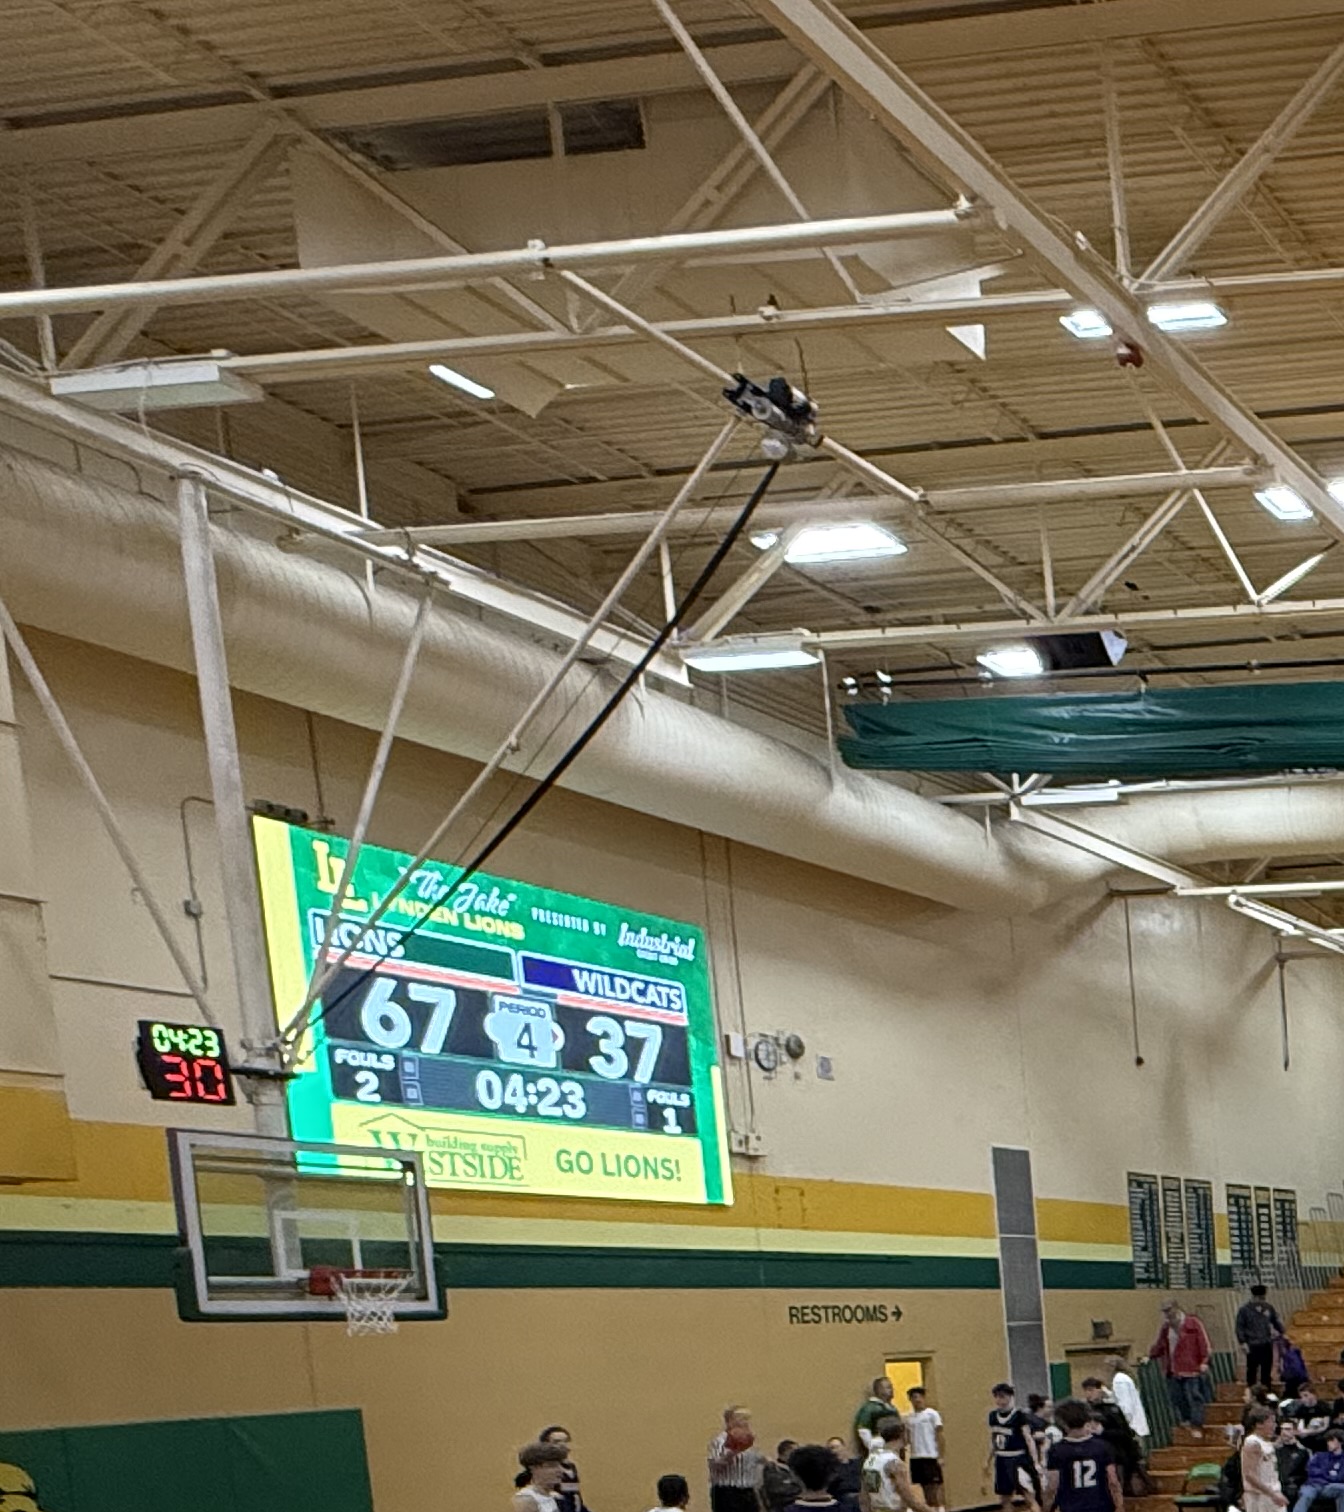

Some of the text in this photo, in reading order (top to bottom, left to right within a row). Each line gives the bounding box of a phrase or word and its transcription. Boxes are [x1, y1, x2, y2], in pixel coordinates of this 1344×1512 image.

[464, 912, 525, 940] LIONS
[617, 922, 696, 961] Industrial
[571, 968, 683, 1010] WILDCATS
[361, 977, 456, 1053] 67
[500, 1002, 546, 1018] PERIOD
[516, 1022, 538, 1058] 4
[586, 1016, 663, 1083] 37
[334, 1048, 395, 1071] FOULS
[161, 1054, 227, 1100] 30
[355, 1071, 381, 1102] 2
[476, 1069, 587, 1119] 04:23
[647, 1089, 691, 1108] FOULS
[663, 1107, 682, 1135] 1
[425, 1134, 477, 1152] building
[556, 1149, 681, 1181] GO LIONS!
[788, 1304, 888, 1324] RESTROOMS
[1072, 1460, 1097, 1488] 12
